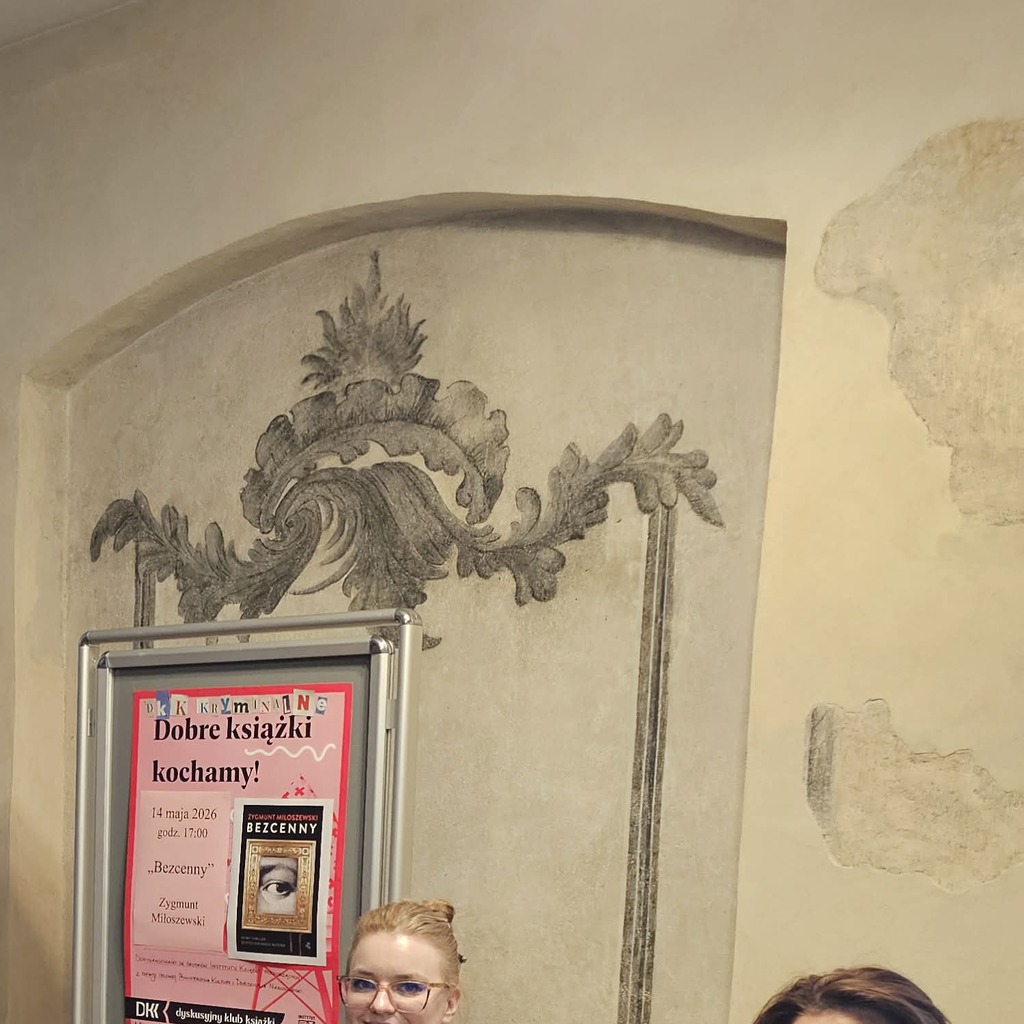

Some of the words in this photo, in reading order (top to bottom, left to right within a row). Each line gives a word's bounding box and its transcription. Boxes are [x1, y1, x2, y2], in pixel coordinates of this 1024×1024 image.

[154, 717, 220, 741] Dobre
[226, 715, 312, 745] książki
[152, 760, 260, 789] kochamy!
[152, 807, 162, 819] 14
[165, 808, 189, 822] maja
[192, 808, 217, 820] 2026
[157, 828, 181, 840] godz.
[184, 828, 208, 839] 17:00
[247, 822, 317, 834] BEZCENNY
[158, 897, 199, 912] Zygmunt
[151, 913, 205, 927] Miłoszewski
[175, 1008, 223, 1024] dyskusyjny
[225, 1013, 243, 1024] klub
